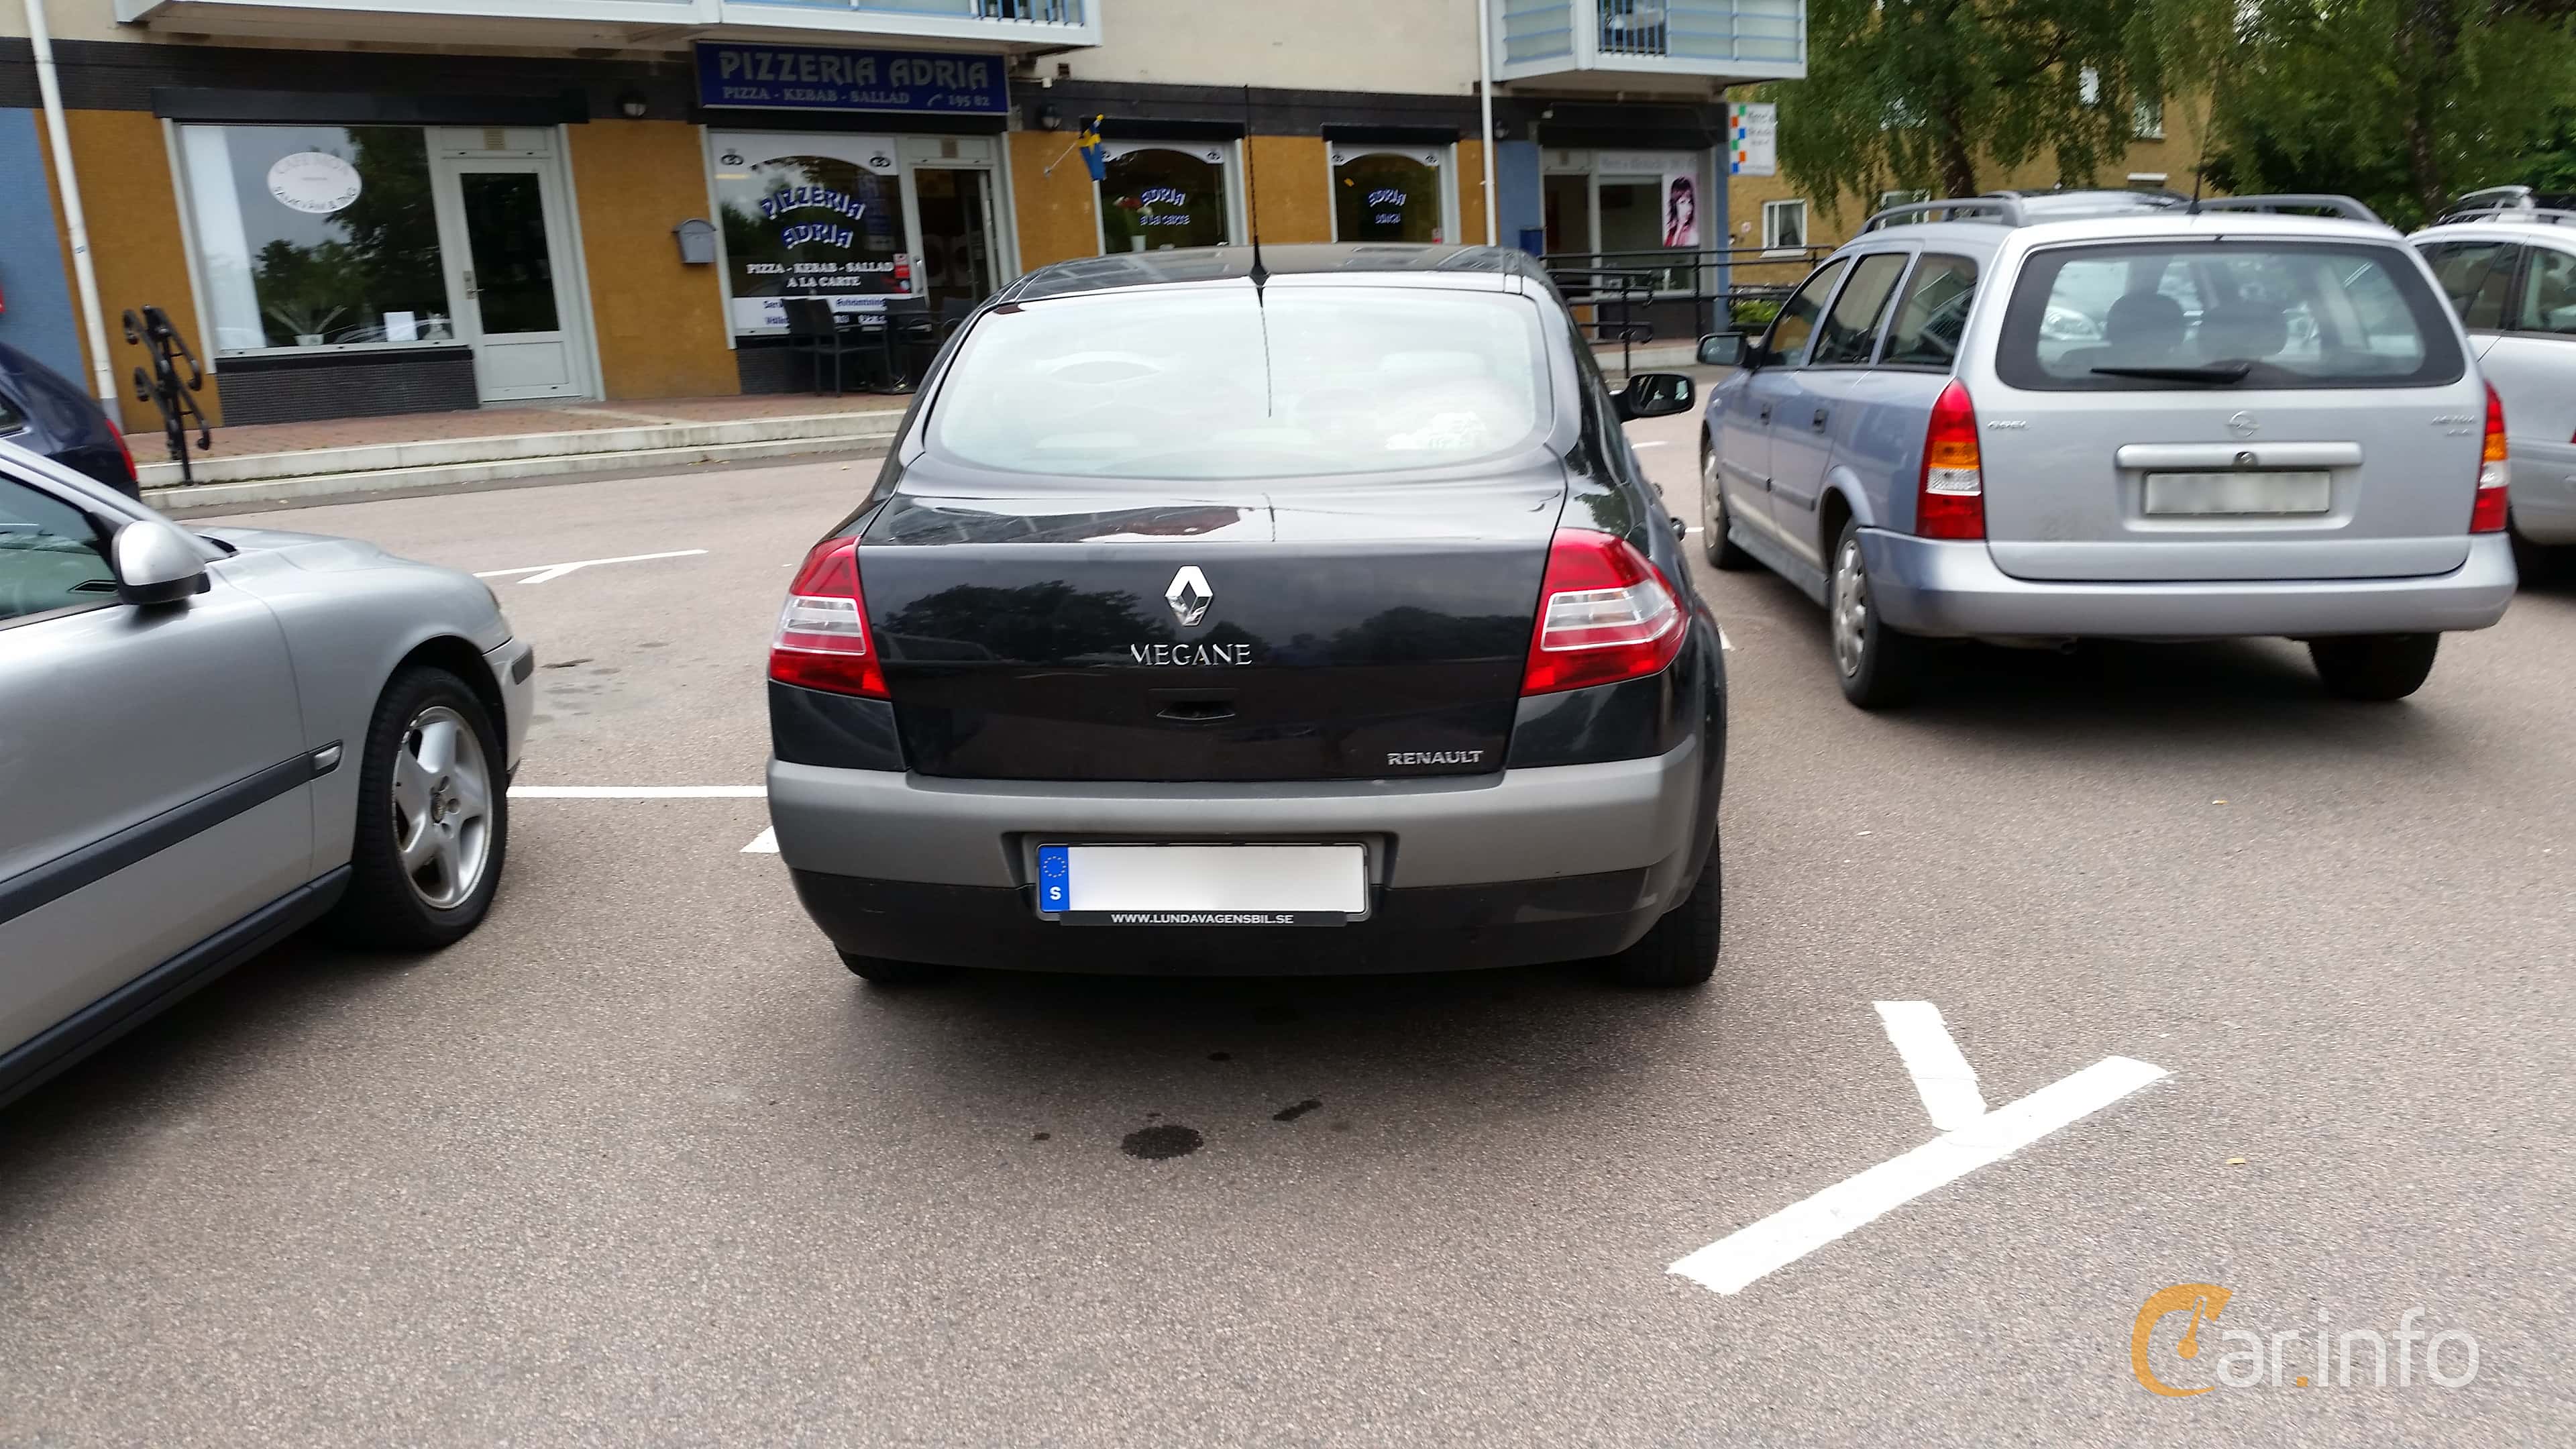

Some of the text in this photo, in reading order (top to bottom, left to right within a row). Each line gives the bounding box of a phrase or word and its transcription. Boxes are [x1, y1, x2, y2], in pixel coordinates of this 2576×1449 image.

[718, 51, 988, 91] PIZZERIA ADRIA
[722, 86, 771, 100] PIZZA
[784, 88, 838, 101] KEBAB
[850, 91, 910, 104] SALLAD
[761, 184, 866, 221] PIZZERIA
[782, 223, 854, 250] ADRIA
[745, 263, 786, 274] PIZZA
[794, 262, 838, 274] KEBAB
[845, 262, 894, 272] SALLAD
[786, 276, 861, 288] A LA CARTE
[1131, 643, 1253, 666] MEGANE
[1387, 749, 1485, 766] RENAULT
[1049, 885, 1062, 901] S
[1111, 913, 1295, 925] WWW.LUNDAVAGENSBIL.SE
